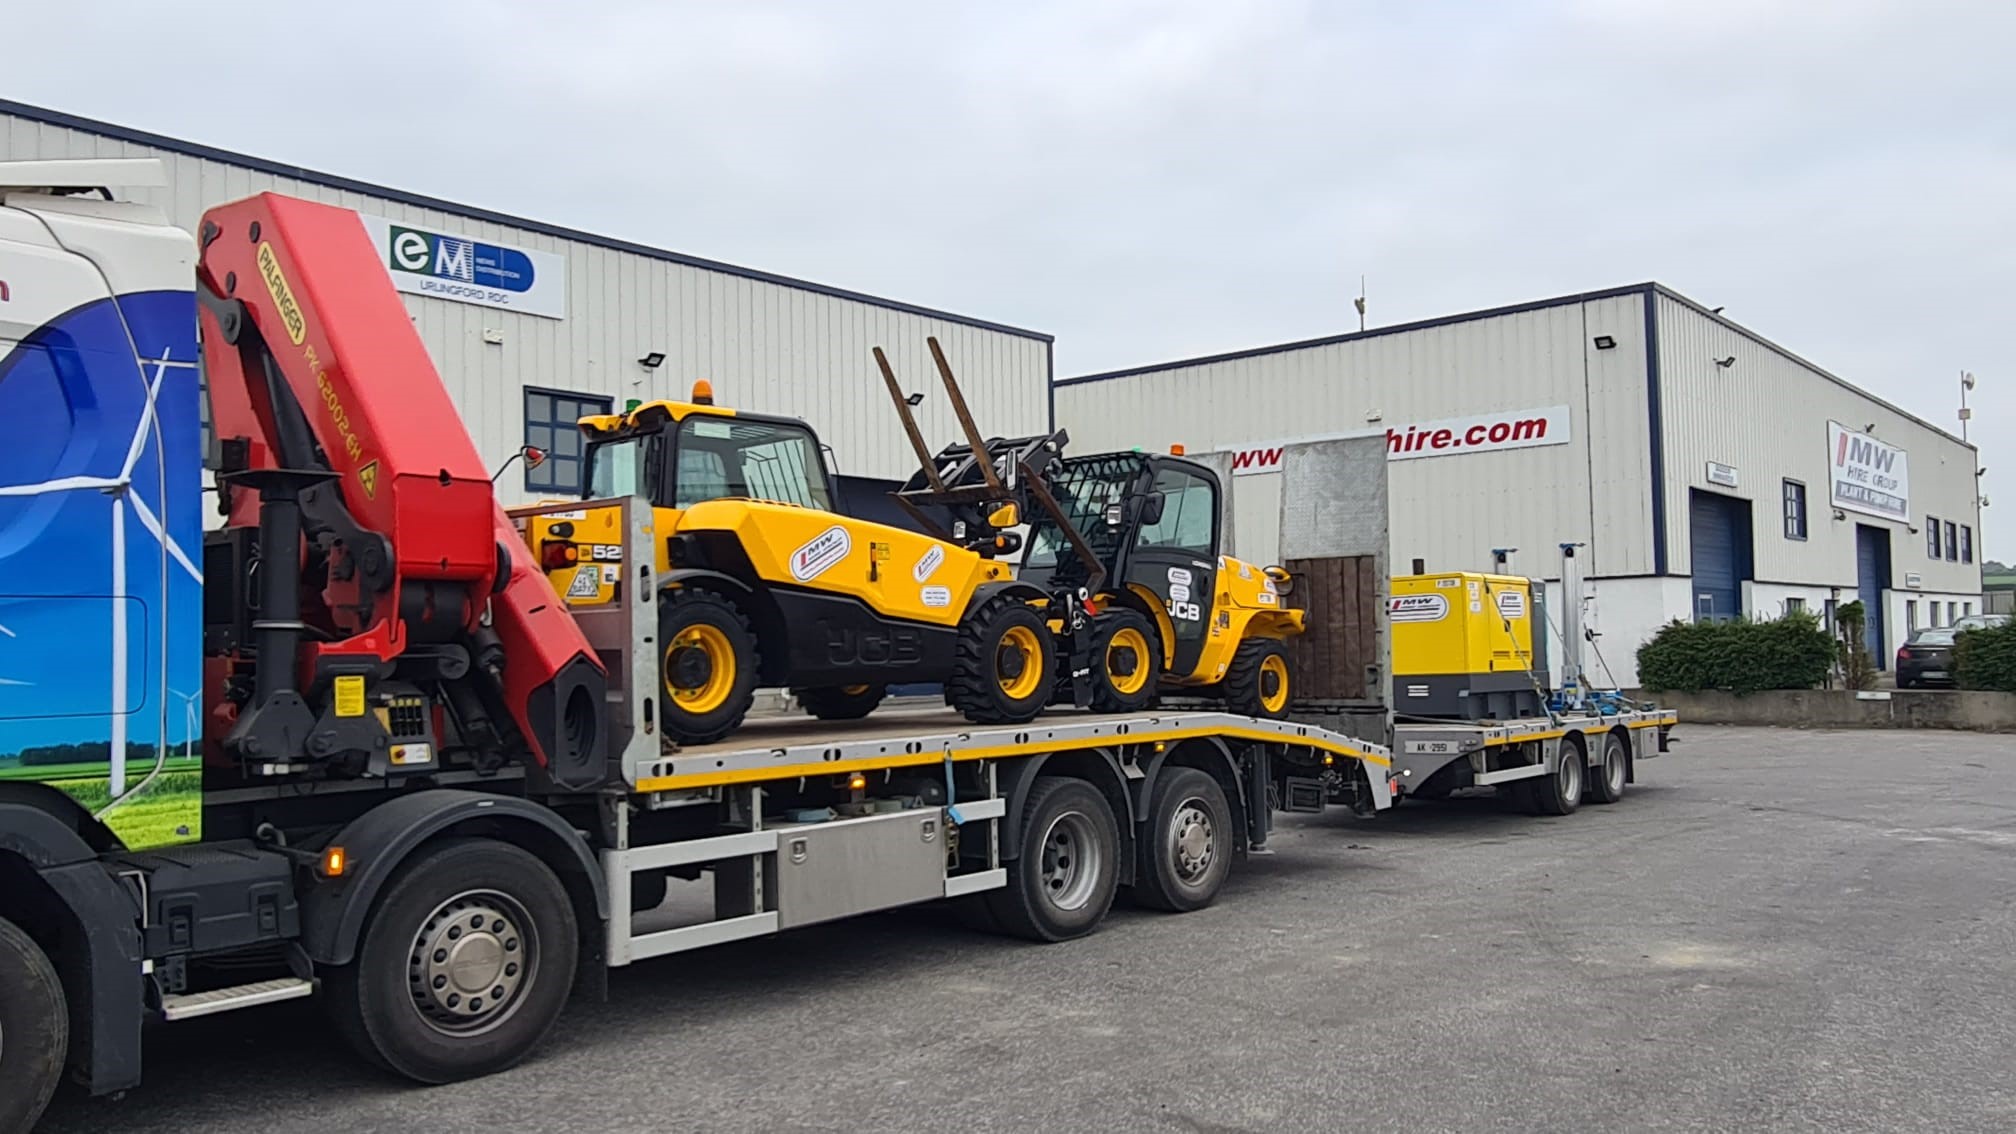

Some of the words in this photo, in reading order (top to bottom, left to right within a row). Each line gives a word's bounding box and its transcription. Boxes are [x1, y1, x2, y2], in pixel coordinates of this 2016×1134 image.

[259, 247, 303, 340] PALFINGER
[420, 280, 484, 300] URLINGFORD
[488, 291, 509, 304] RDC
[303, 345, 320, 374] PK
[1847, 465, 1869, 483] HIRE
[1872, 474, 1898, 490] GROUP
[1167, 600, 1200, 621] JCB
[827, 627, 921, 665] JCB
